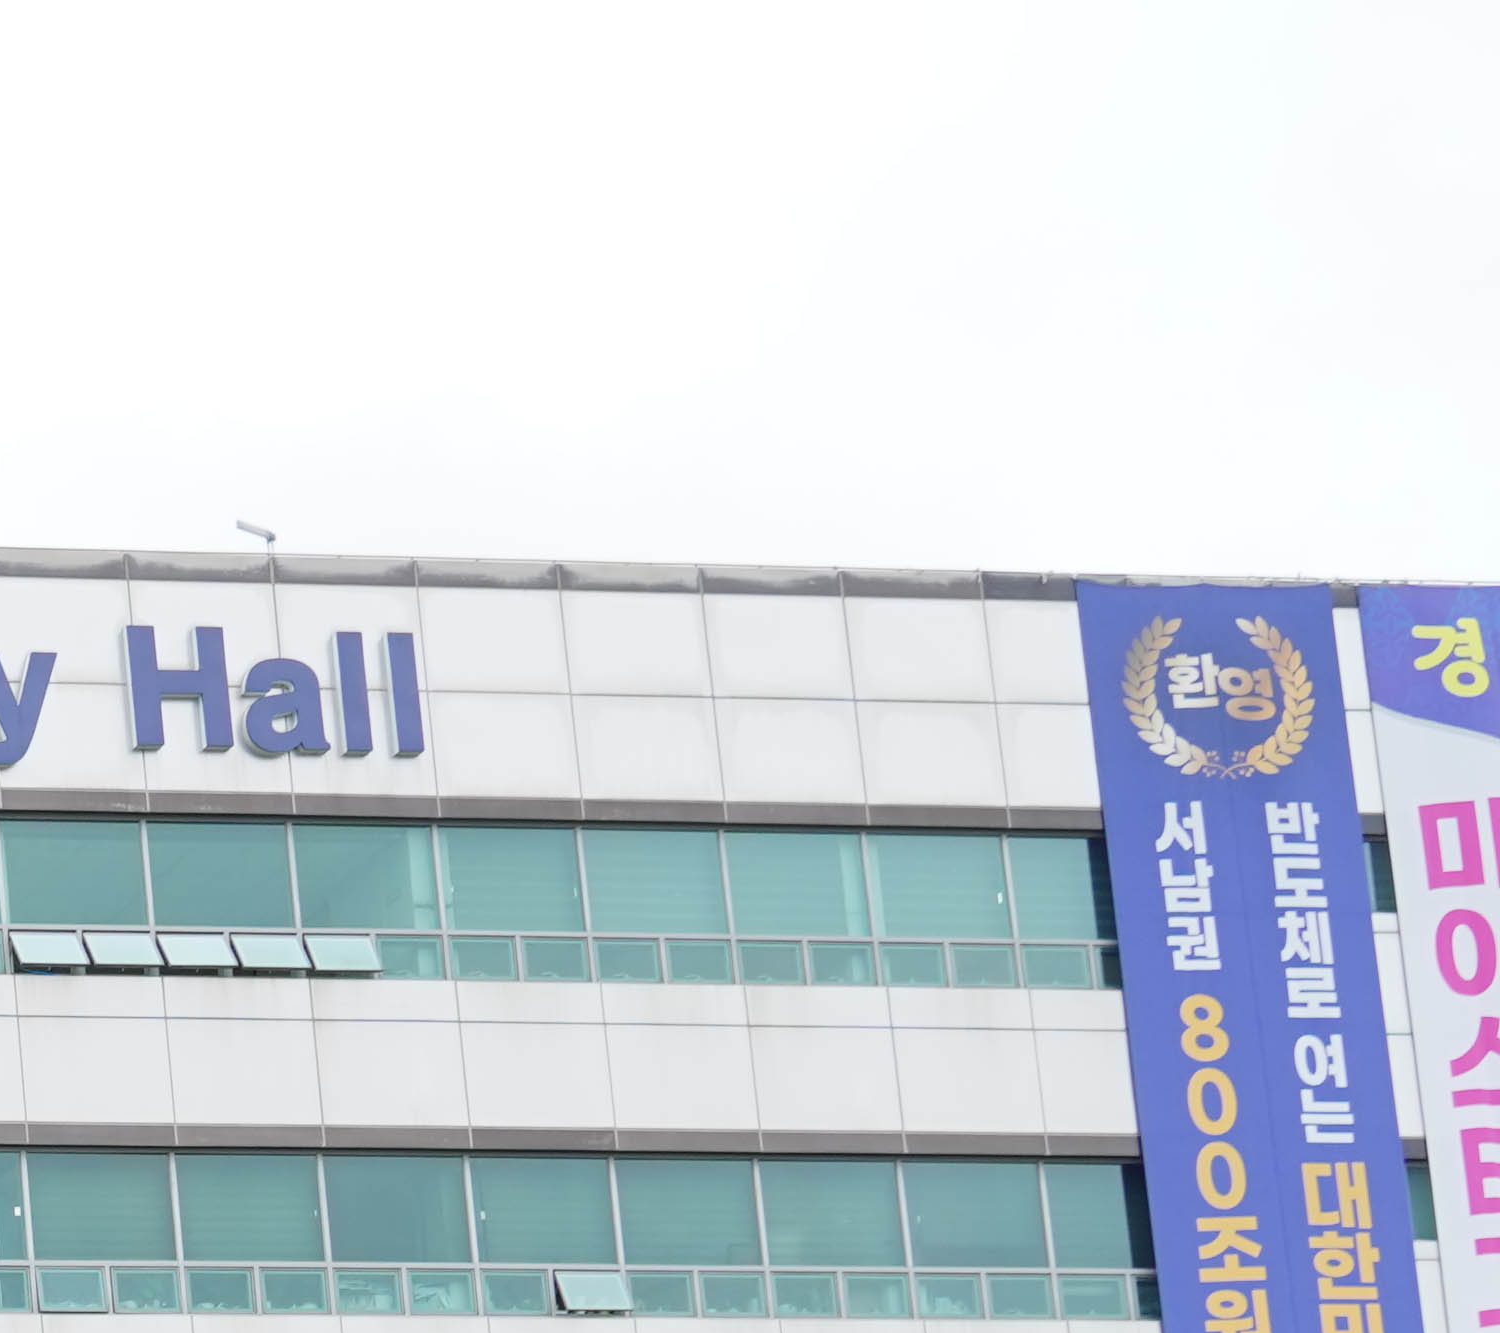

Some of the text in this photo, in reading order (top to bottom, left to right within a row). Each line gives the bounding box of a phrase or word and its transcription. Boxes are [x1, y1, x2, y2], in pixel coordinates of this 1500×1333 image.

[125, 624, 426, 758] Hall
[1163, 653, 1277, 722] 환영
[1155, 800, 1222, 972] 서남권
[1264, 801, 1343, 1019] 반도체로
[1293, 1033, 1356, 1144] 여는
